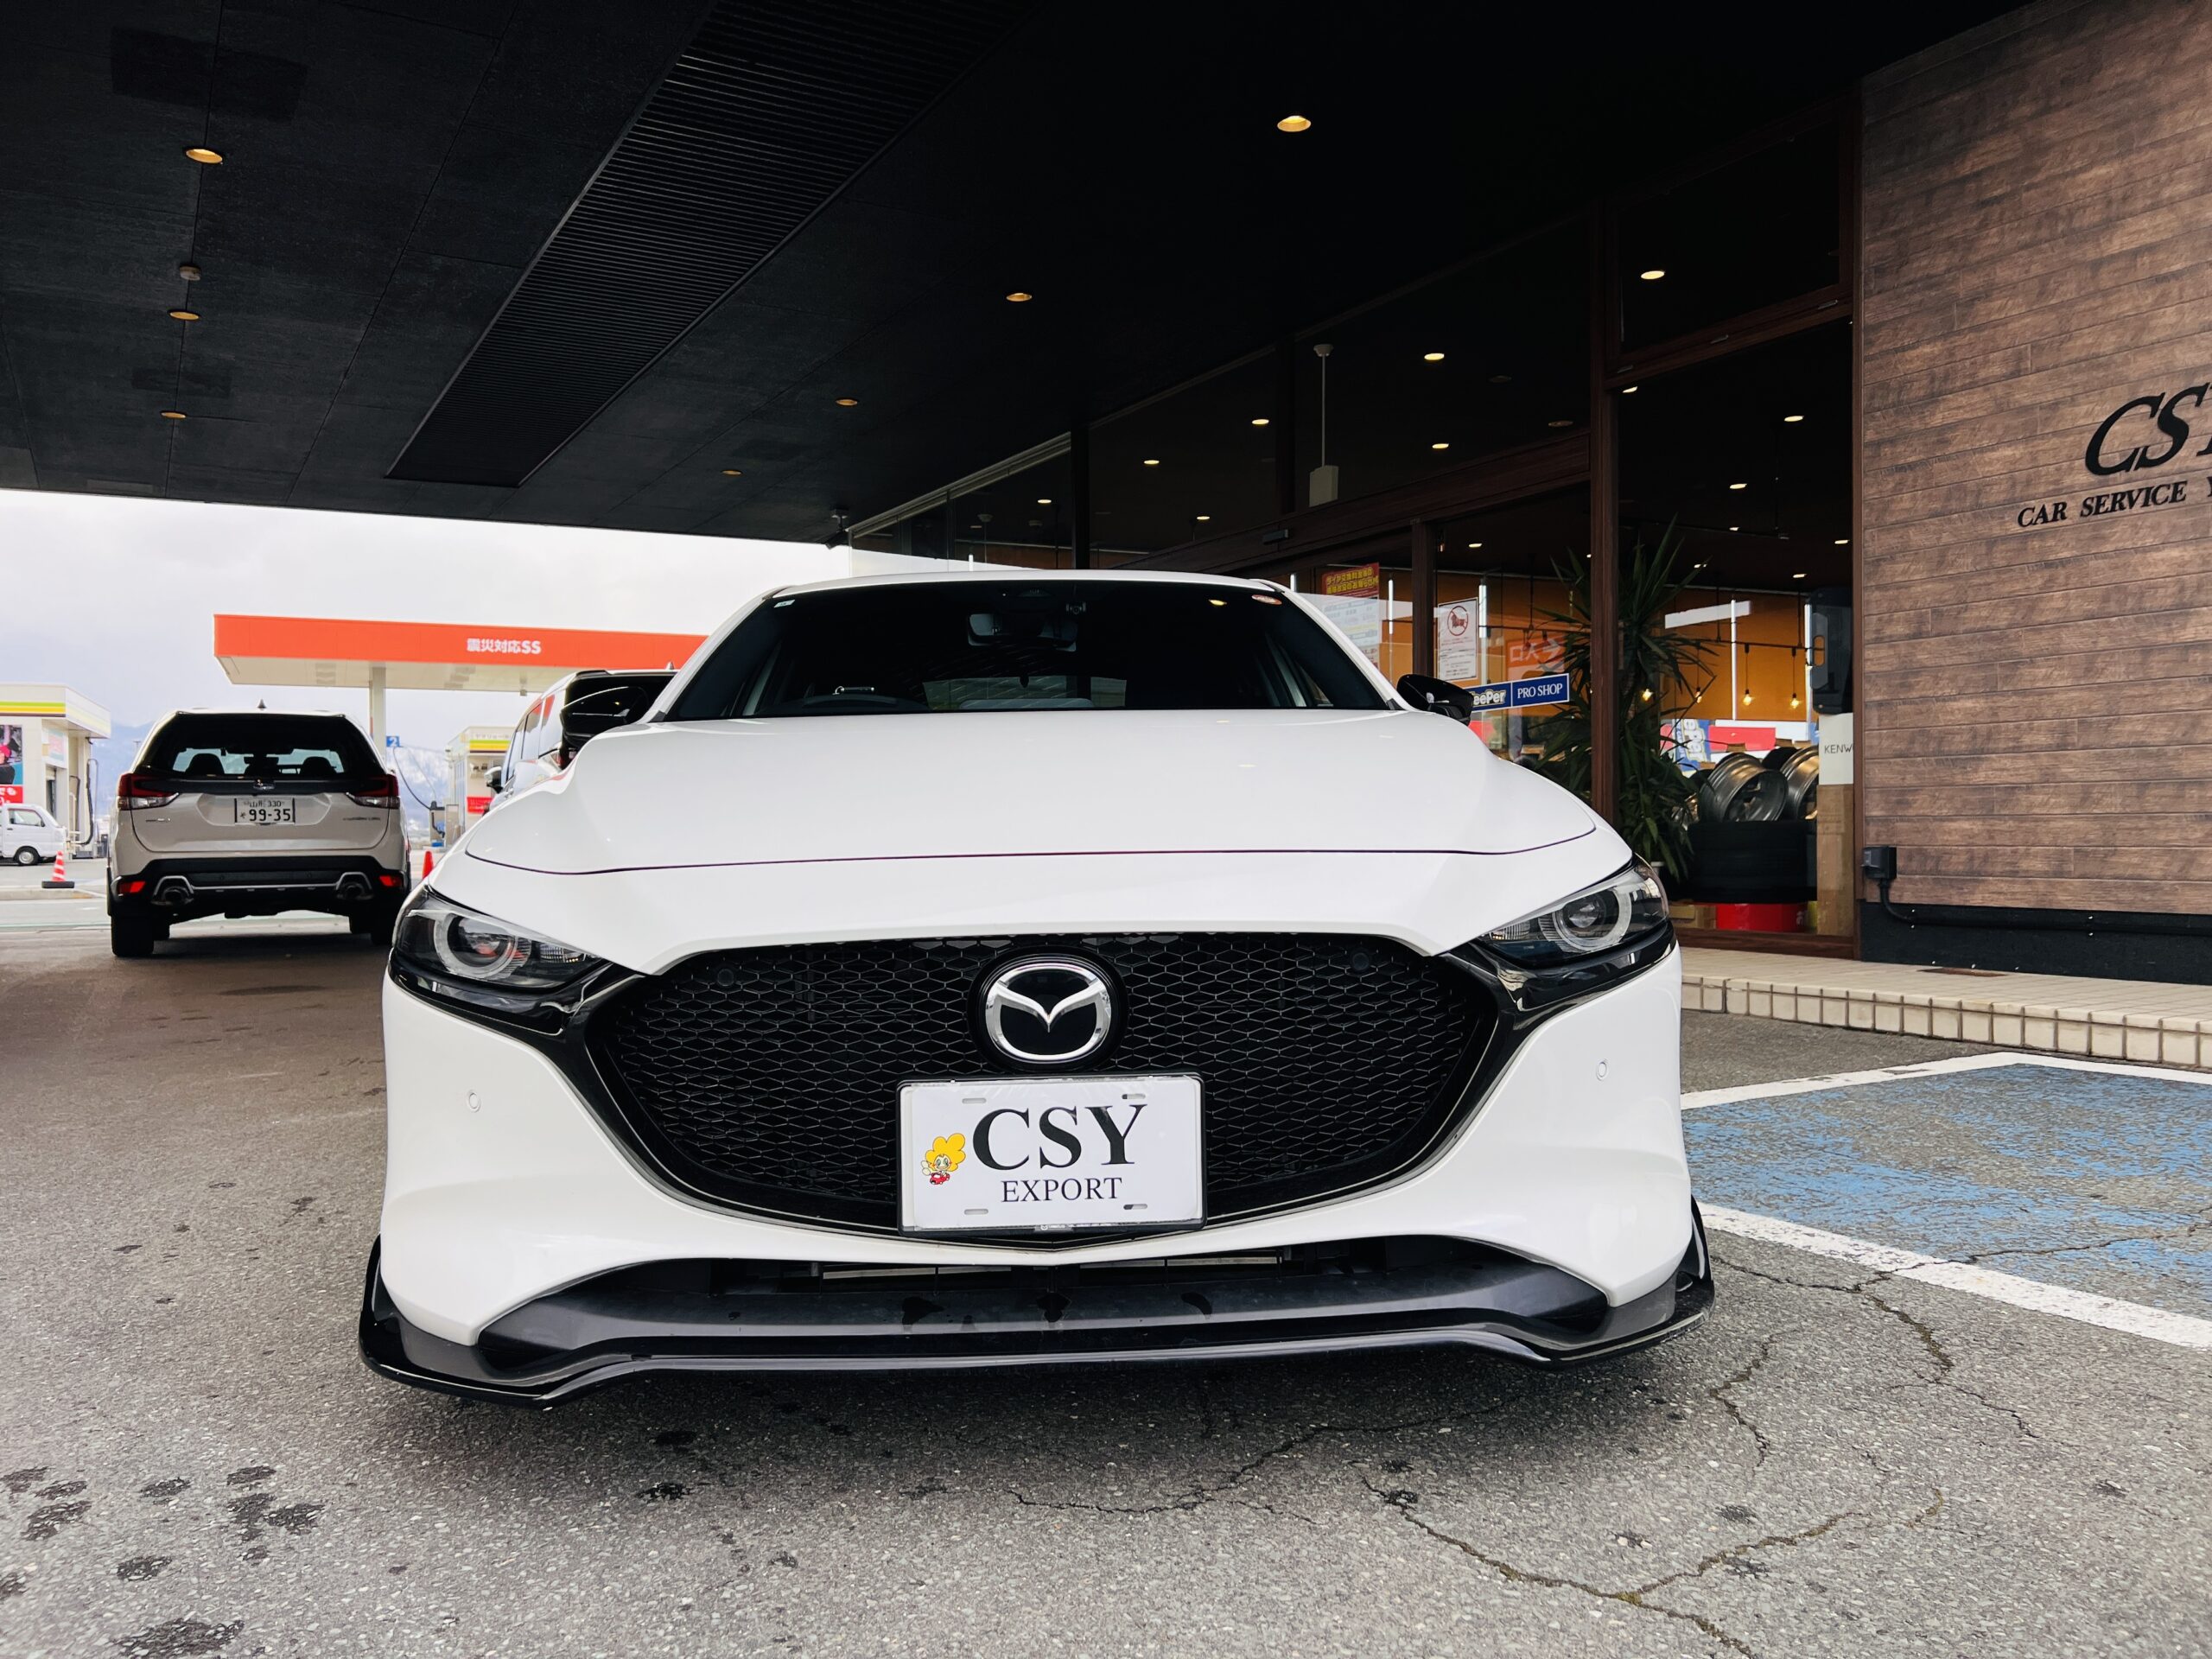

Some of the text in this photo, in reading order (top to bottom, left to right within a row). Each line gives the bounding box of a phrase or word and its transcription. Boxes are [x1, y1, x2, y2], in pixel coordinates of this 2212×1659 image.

[2017, 501, 2068, 528] CAR
[2079, 480, 2188, 518] SERVICE
[467, 638, 542, 654] 震災対応SS
[1471, 683, 1563, 708] eePer PRO SHOP
[1824, 743, 1853, 754] KENW
[249, 809, 291, 822] 99-35
[972, 1103, 1147, 1171] CSY
[1001, 1177, 1122, 1203] EXPORT
